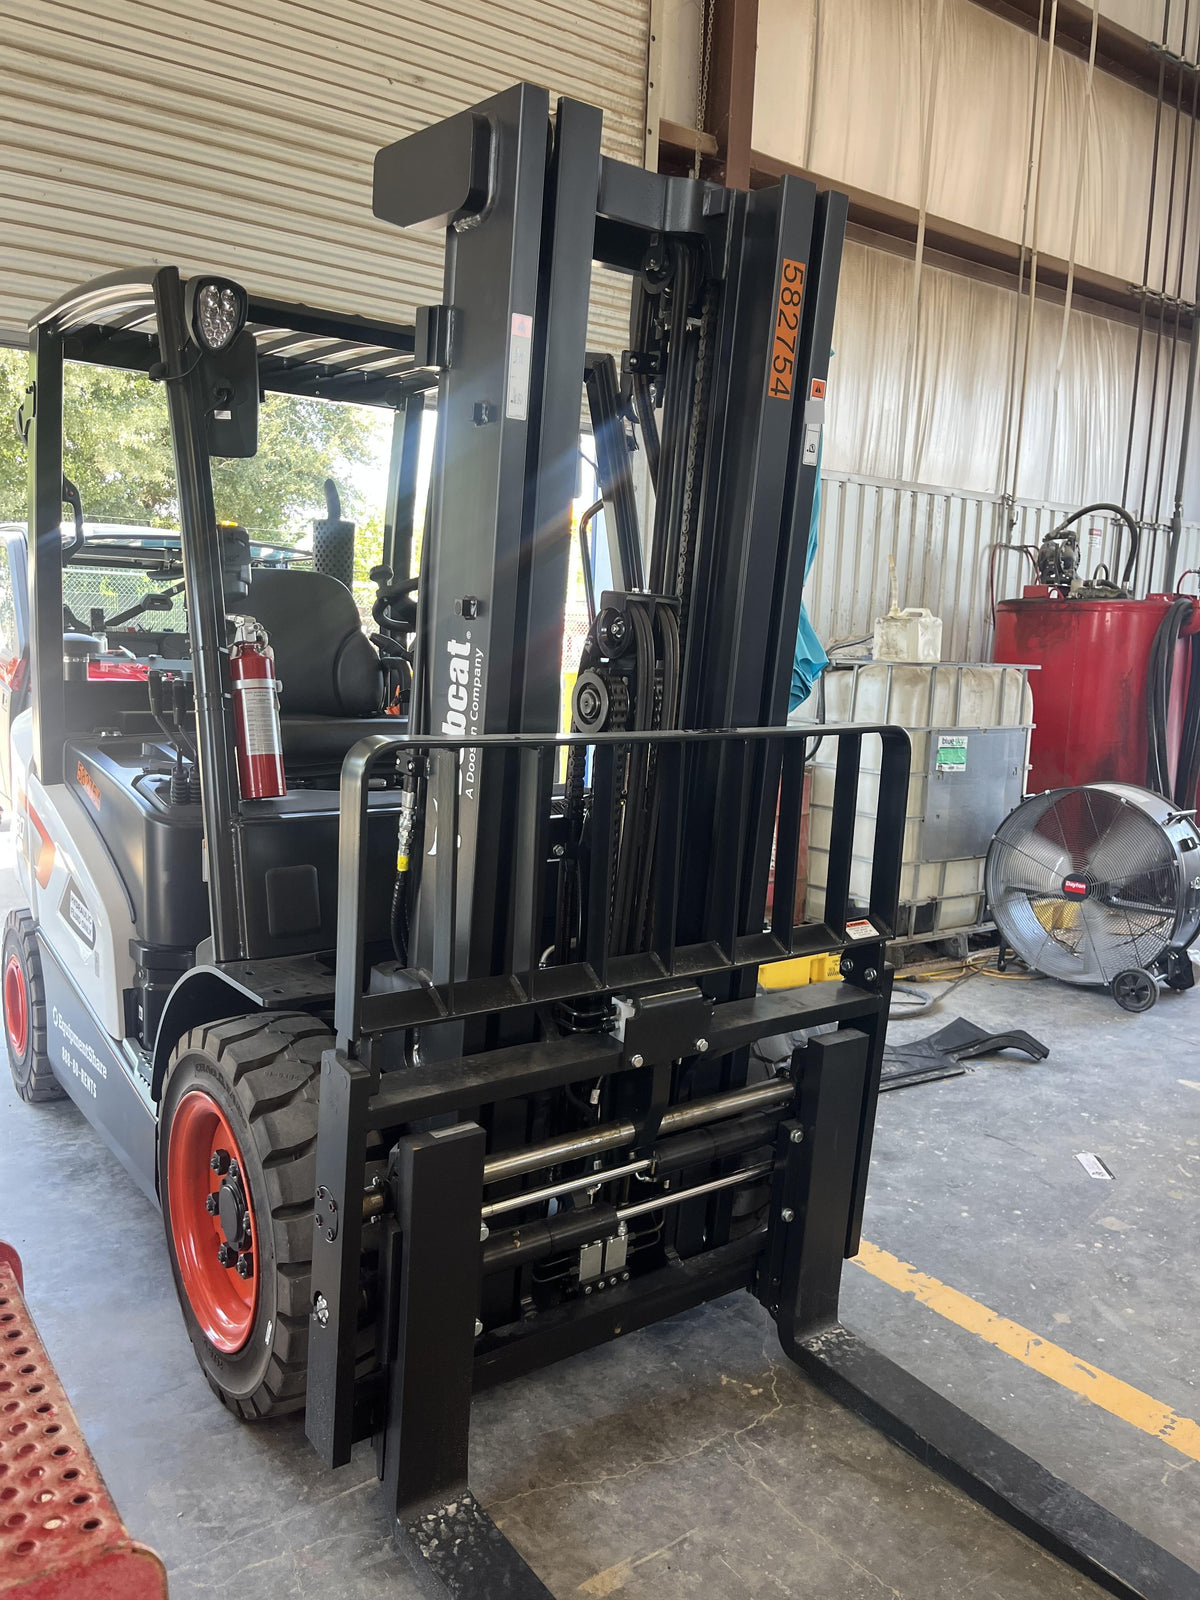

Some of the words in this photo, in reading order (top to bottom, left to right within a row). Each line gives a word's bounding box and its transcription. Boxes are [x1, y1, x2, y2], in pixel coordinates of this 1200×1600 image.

[770, 263, 804, 397] 582754
[470, 647, 484, 722] Company
[466, 727, 478, 783] Doosn
[465, 788, 474, 800] A
[1065, 880, 1086, 889] Dayton
[58, 1013, 107, 1079] EquipmentShare
